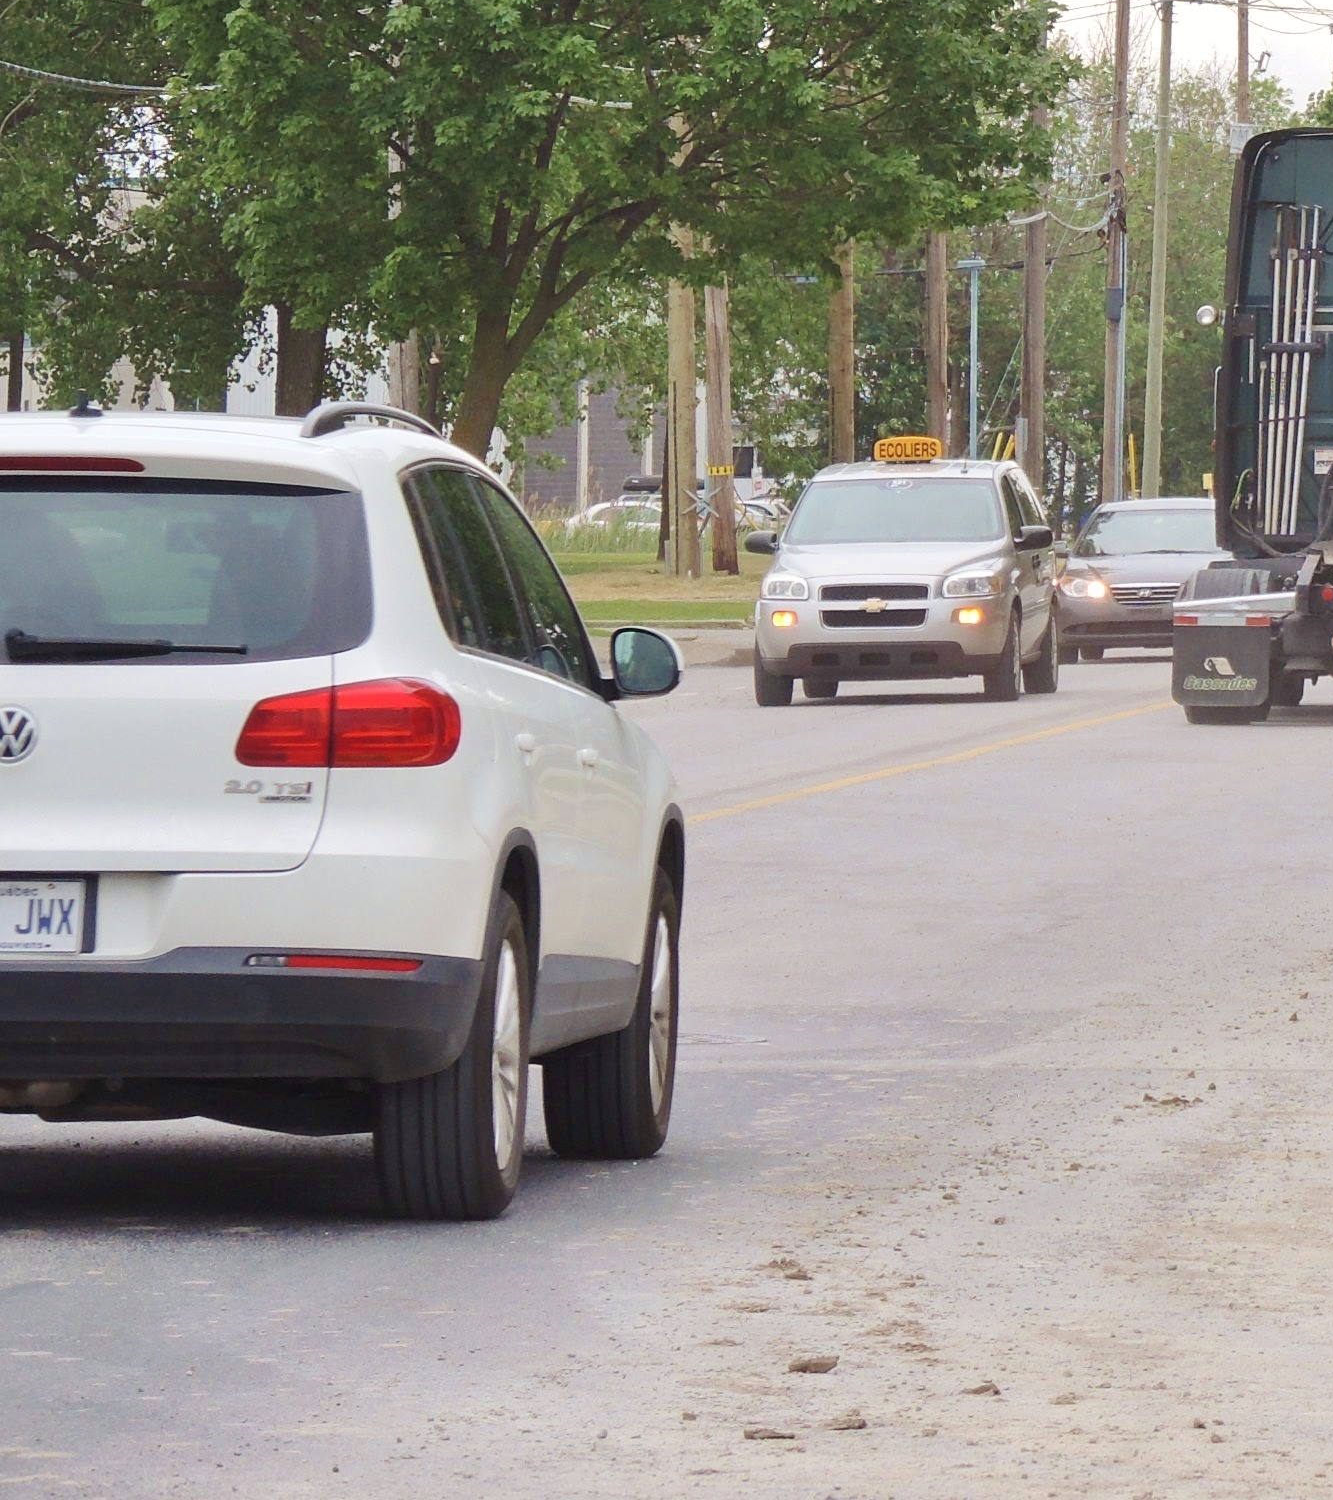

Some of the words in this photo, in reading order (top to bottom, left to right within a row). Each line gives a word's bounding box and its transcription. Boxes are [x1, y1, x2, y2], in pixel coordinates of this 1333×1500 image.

[879, 442, 937, 458] ECOLIERS
[1183, 675, 1257, 691] Cascades
[15, 898, 75, 935] JWX
